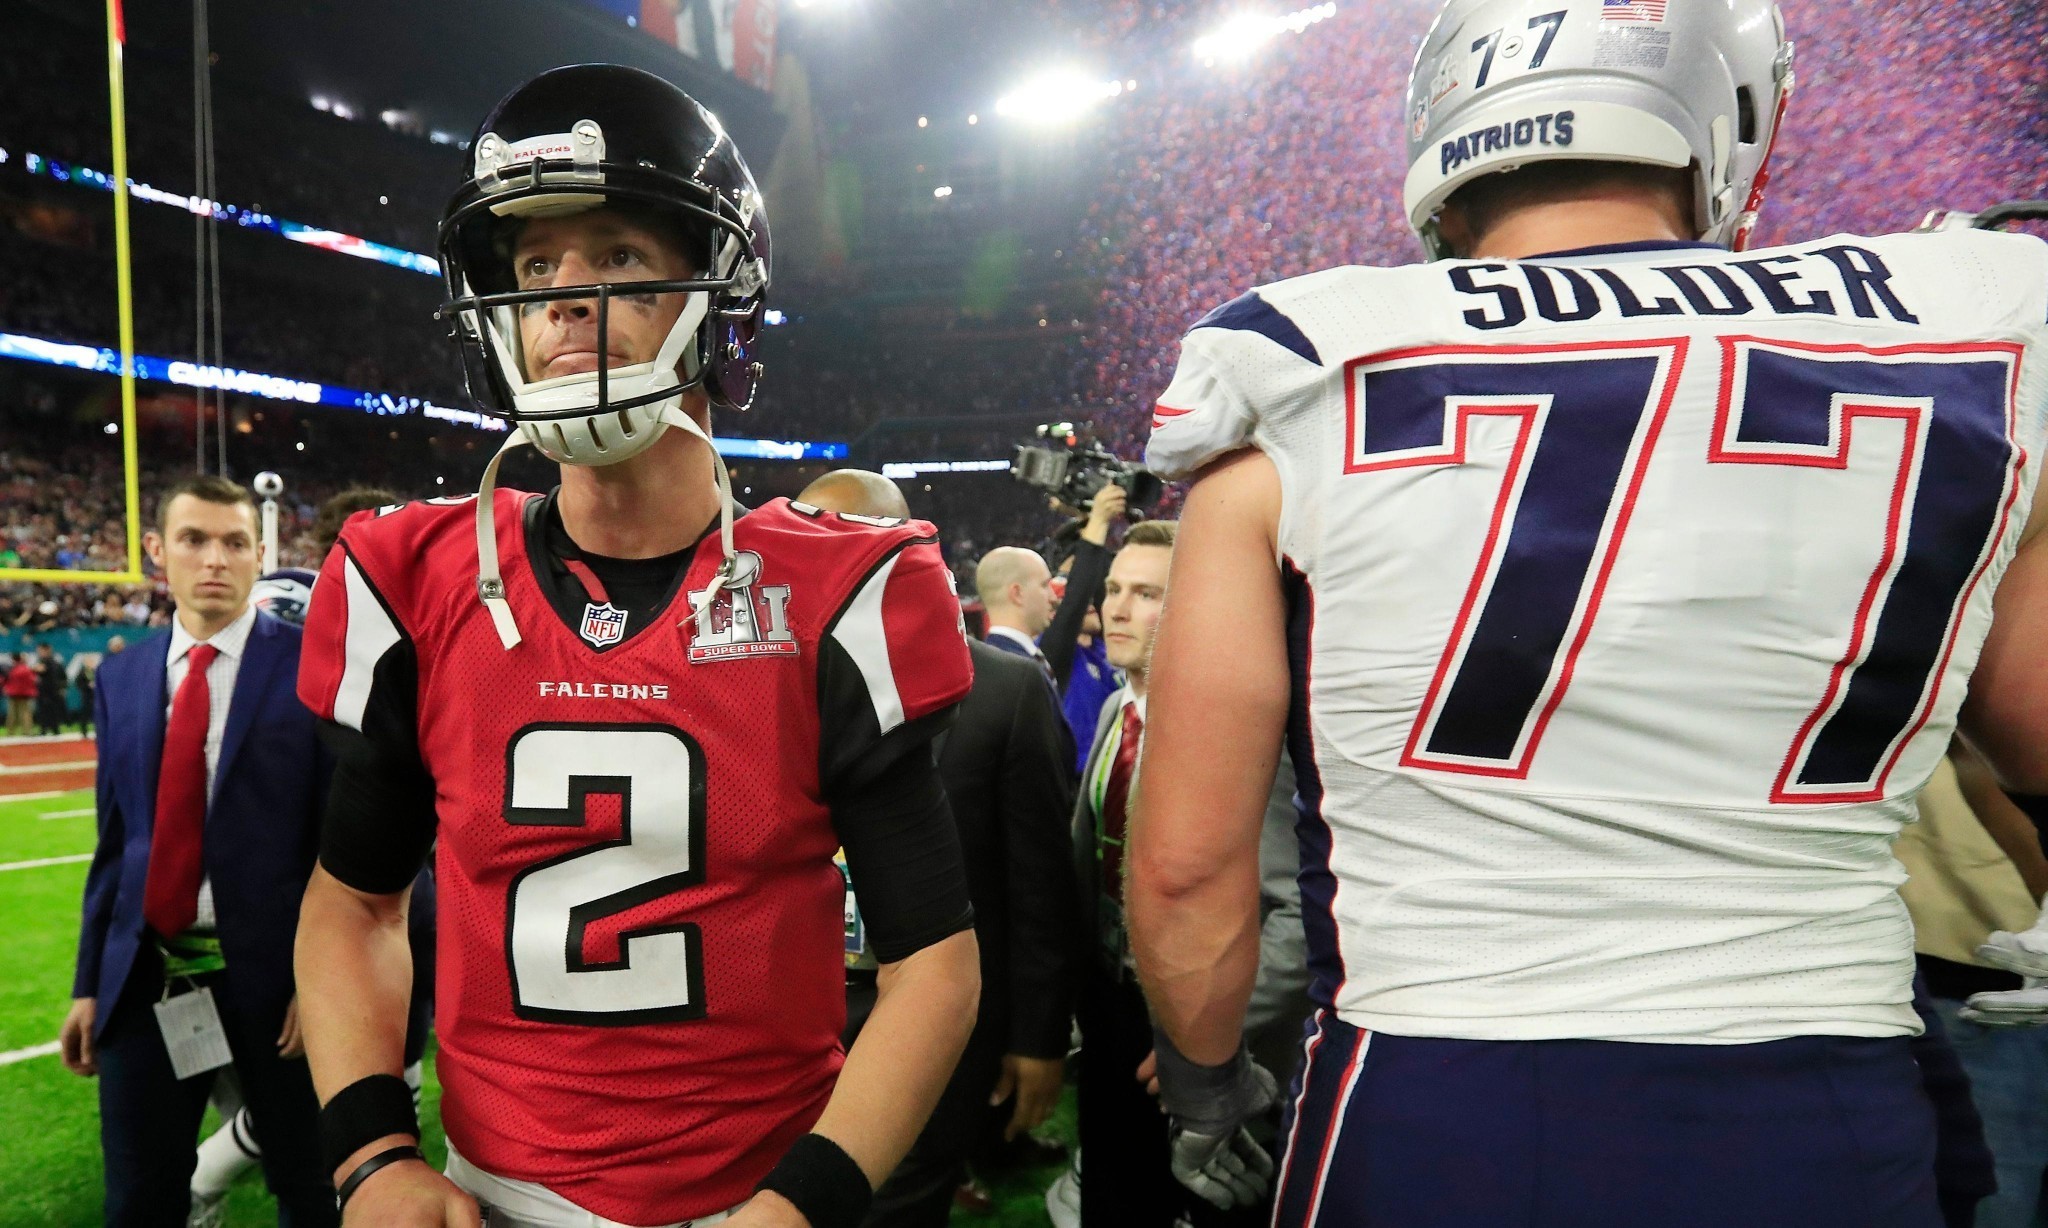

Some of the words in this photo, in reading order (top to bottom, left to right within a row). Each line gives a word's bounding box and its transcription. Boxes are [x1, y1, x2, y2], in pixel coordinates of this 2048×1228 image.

[514, 145, 571, 159] FALCONS
[1441, 110, 1574, 175] PATRIOTS
[1448, 245, 1919, 330] SOLDER
[1344, 336, 2025, 804] 77
[587, 620, 617, 638] NFL
[703, 645, 747, 657] SUPER
[751, 642, 786, 653] BOWL
[539, 681, 669, 700] FALCONS
[505, 722, 705, 1023] 2
